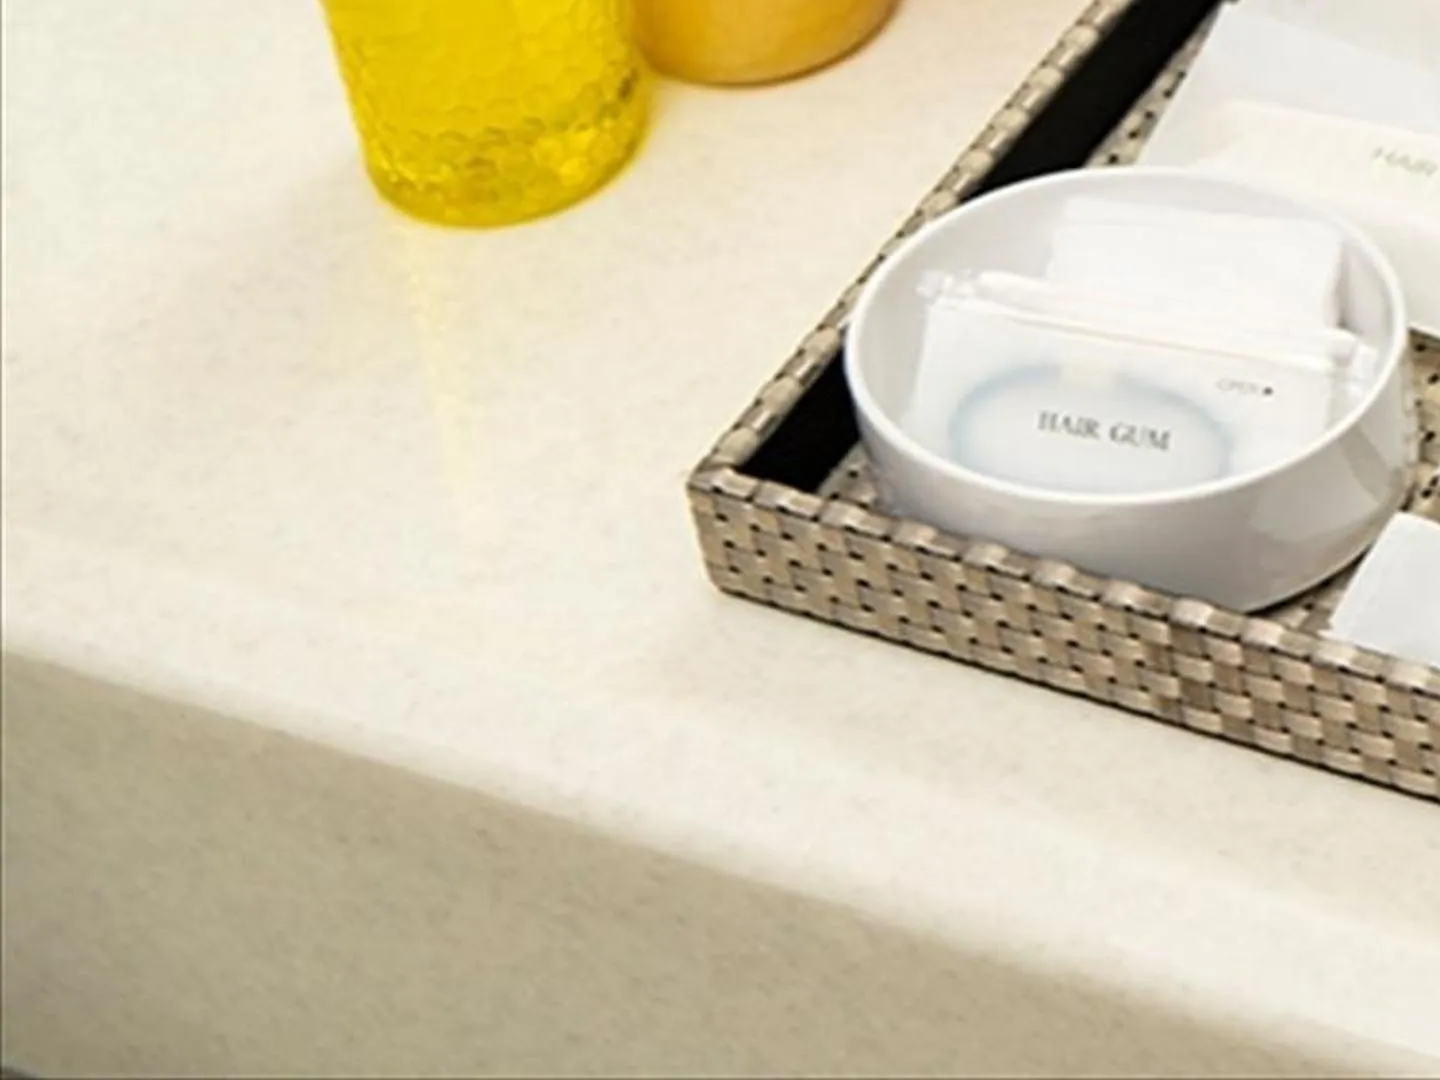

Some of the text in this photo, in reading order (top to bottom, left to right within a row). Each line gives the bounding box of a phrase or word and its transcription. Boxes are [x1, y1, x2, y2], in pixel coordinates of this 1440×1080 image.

[1371, 144, 1440, 180] HAIR
[1036, 409, 1172, 453] HAIR GUM
